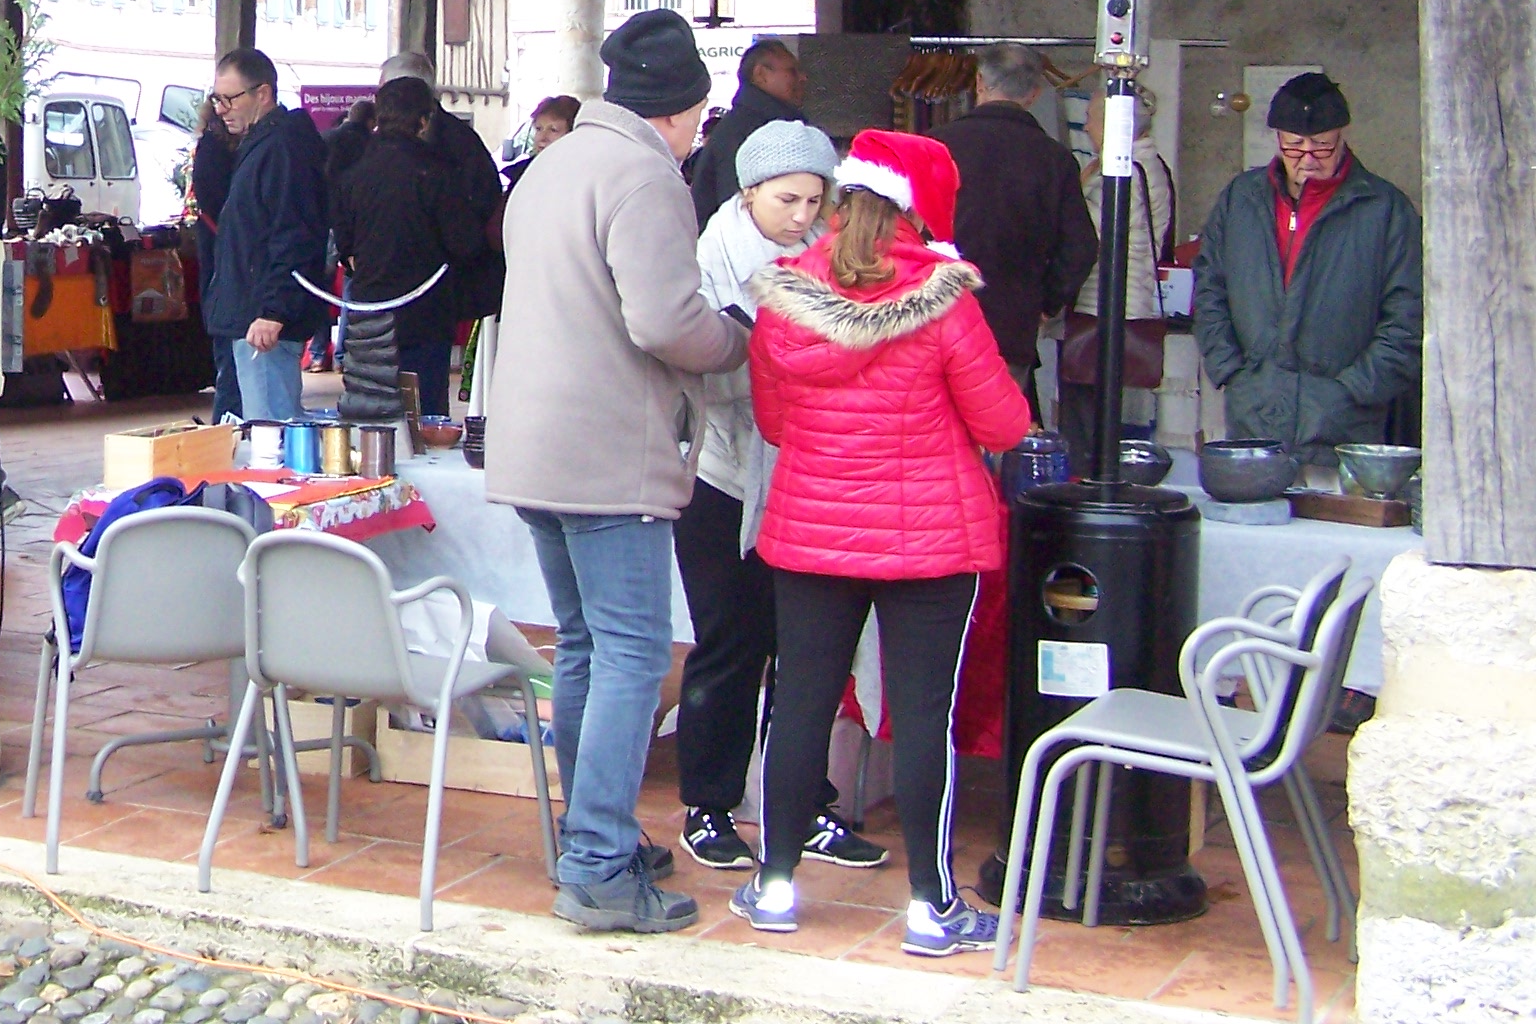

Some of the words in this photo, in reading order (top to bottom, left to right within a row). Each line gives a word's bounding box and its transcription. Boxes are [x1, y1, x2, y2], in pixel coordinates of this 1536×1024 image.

[697, 46, 745, 58] AGRIC
[304, 93, 319, 104] Des
[320, 93, 344, 106] bijoux
